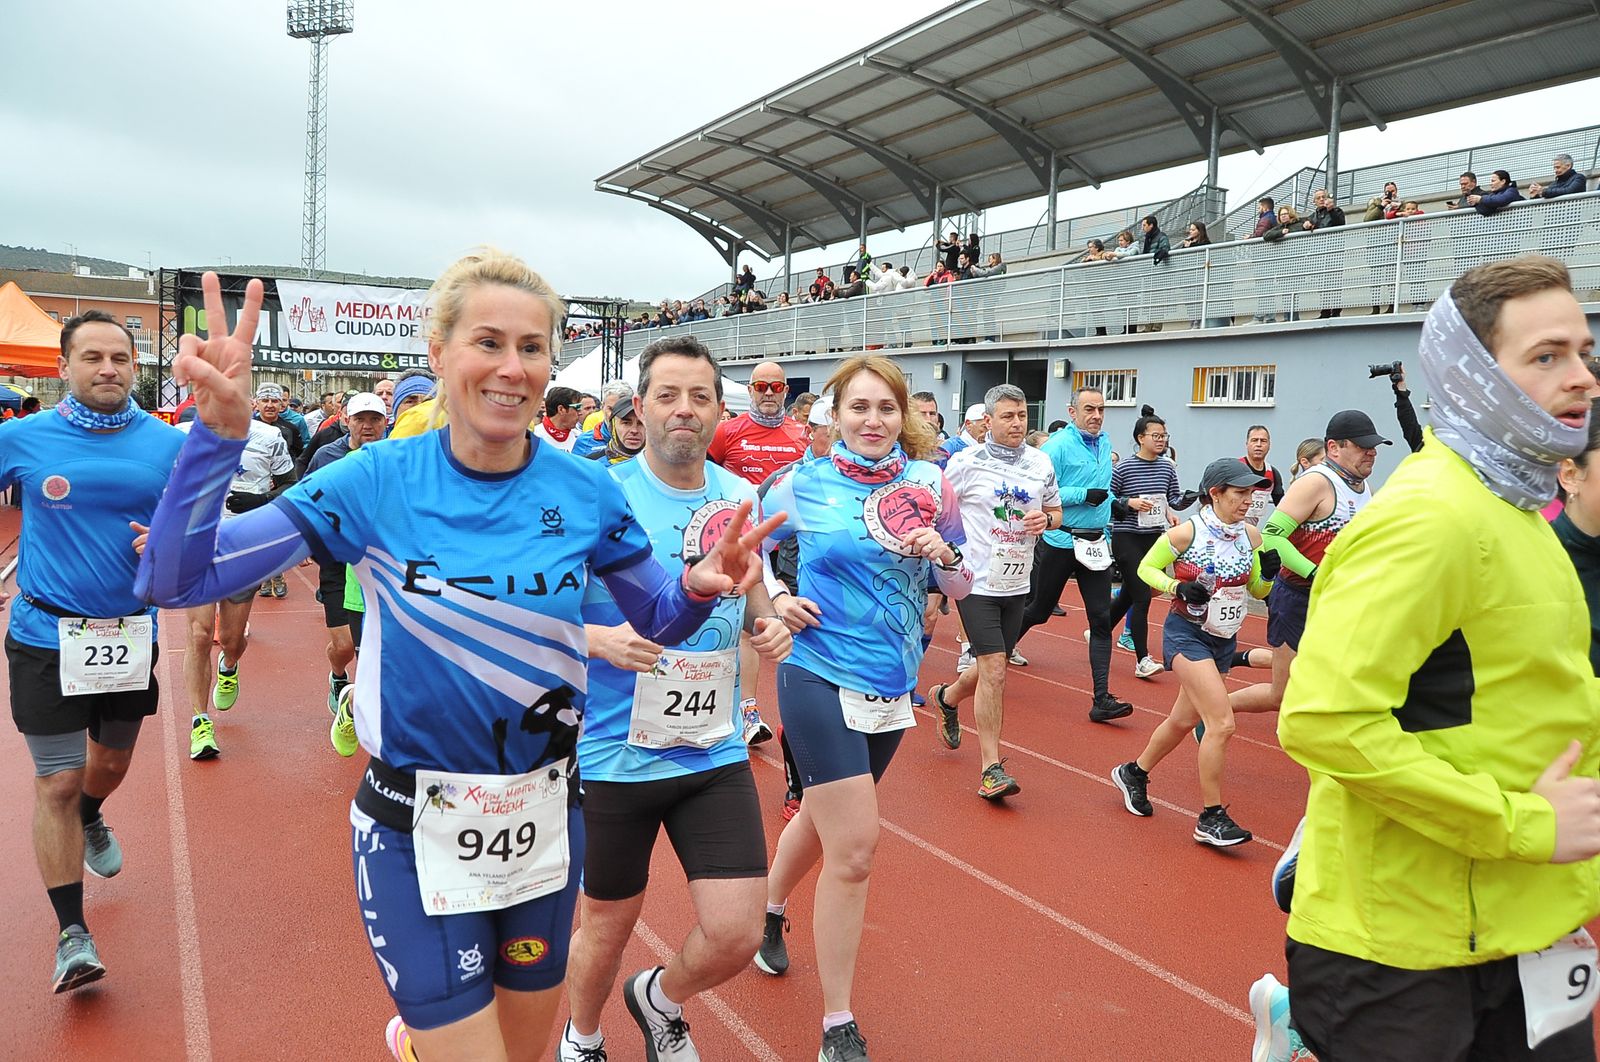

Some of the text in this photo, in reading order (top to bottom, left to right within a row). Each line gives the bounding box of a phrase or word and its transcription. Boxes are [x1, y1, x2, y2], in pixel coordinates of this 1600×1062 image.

[335, 301, 393, 320] MEDIA
[335, 320, 396, 336] CIUDAD
[399, 323, 419, 337] DE
[1002, 562, 1025, 576] 772
[1219, 604, 1242, 621] 556
[84, 644, 129, 667] 232
[663, 689, 717, 717] 244
[482, 799, 529, 815] LUCENA
[457, 821, 536, 862] 949
